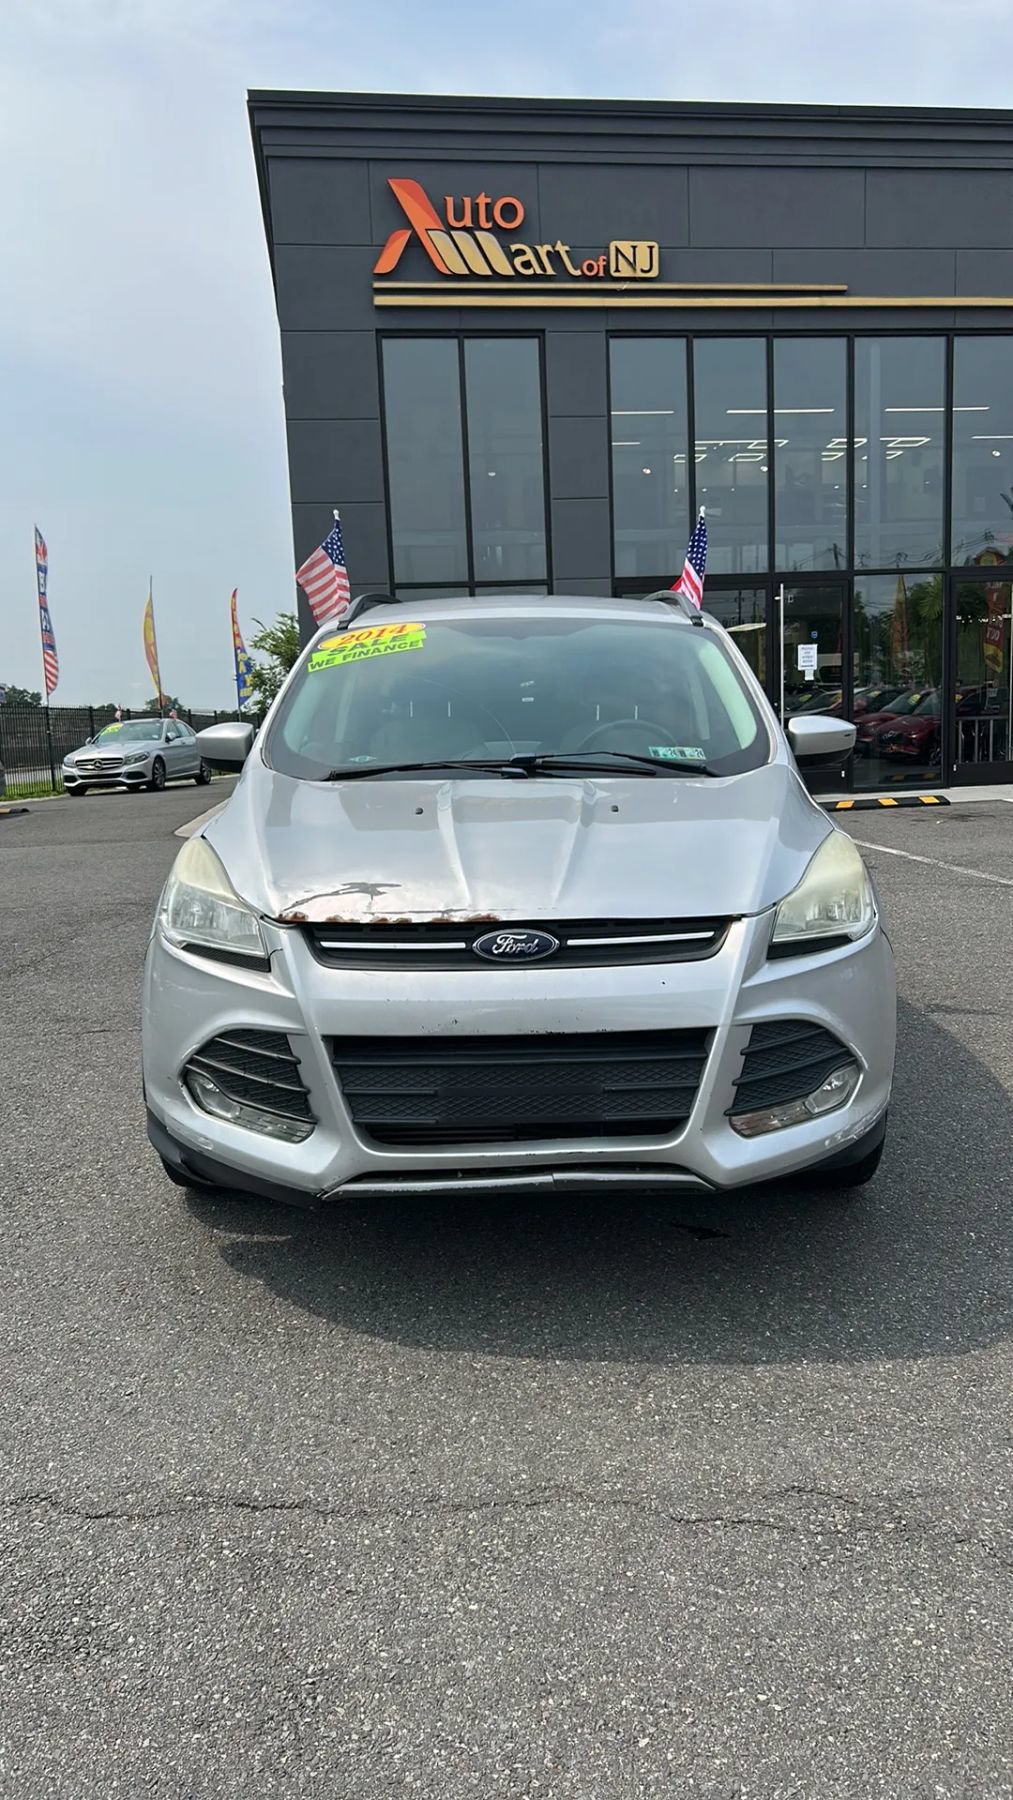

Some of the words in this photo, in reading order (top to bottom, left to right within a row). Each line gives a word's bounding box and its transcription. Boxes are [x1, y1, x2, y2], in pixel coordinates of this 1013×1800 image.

[582, 256, 607, 277] of
[613, 244, 656, 273] NJ
[338, 624, 408, 645] 2014
[310, 656, 337, 669] WE
[342, 640, 419, 660] FINANCE
[327, 635, 407, 656] SALE
[492, 934, 539, 954] Ford
